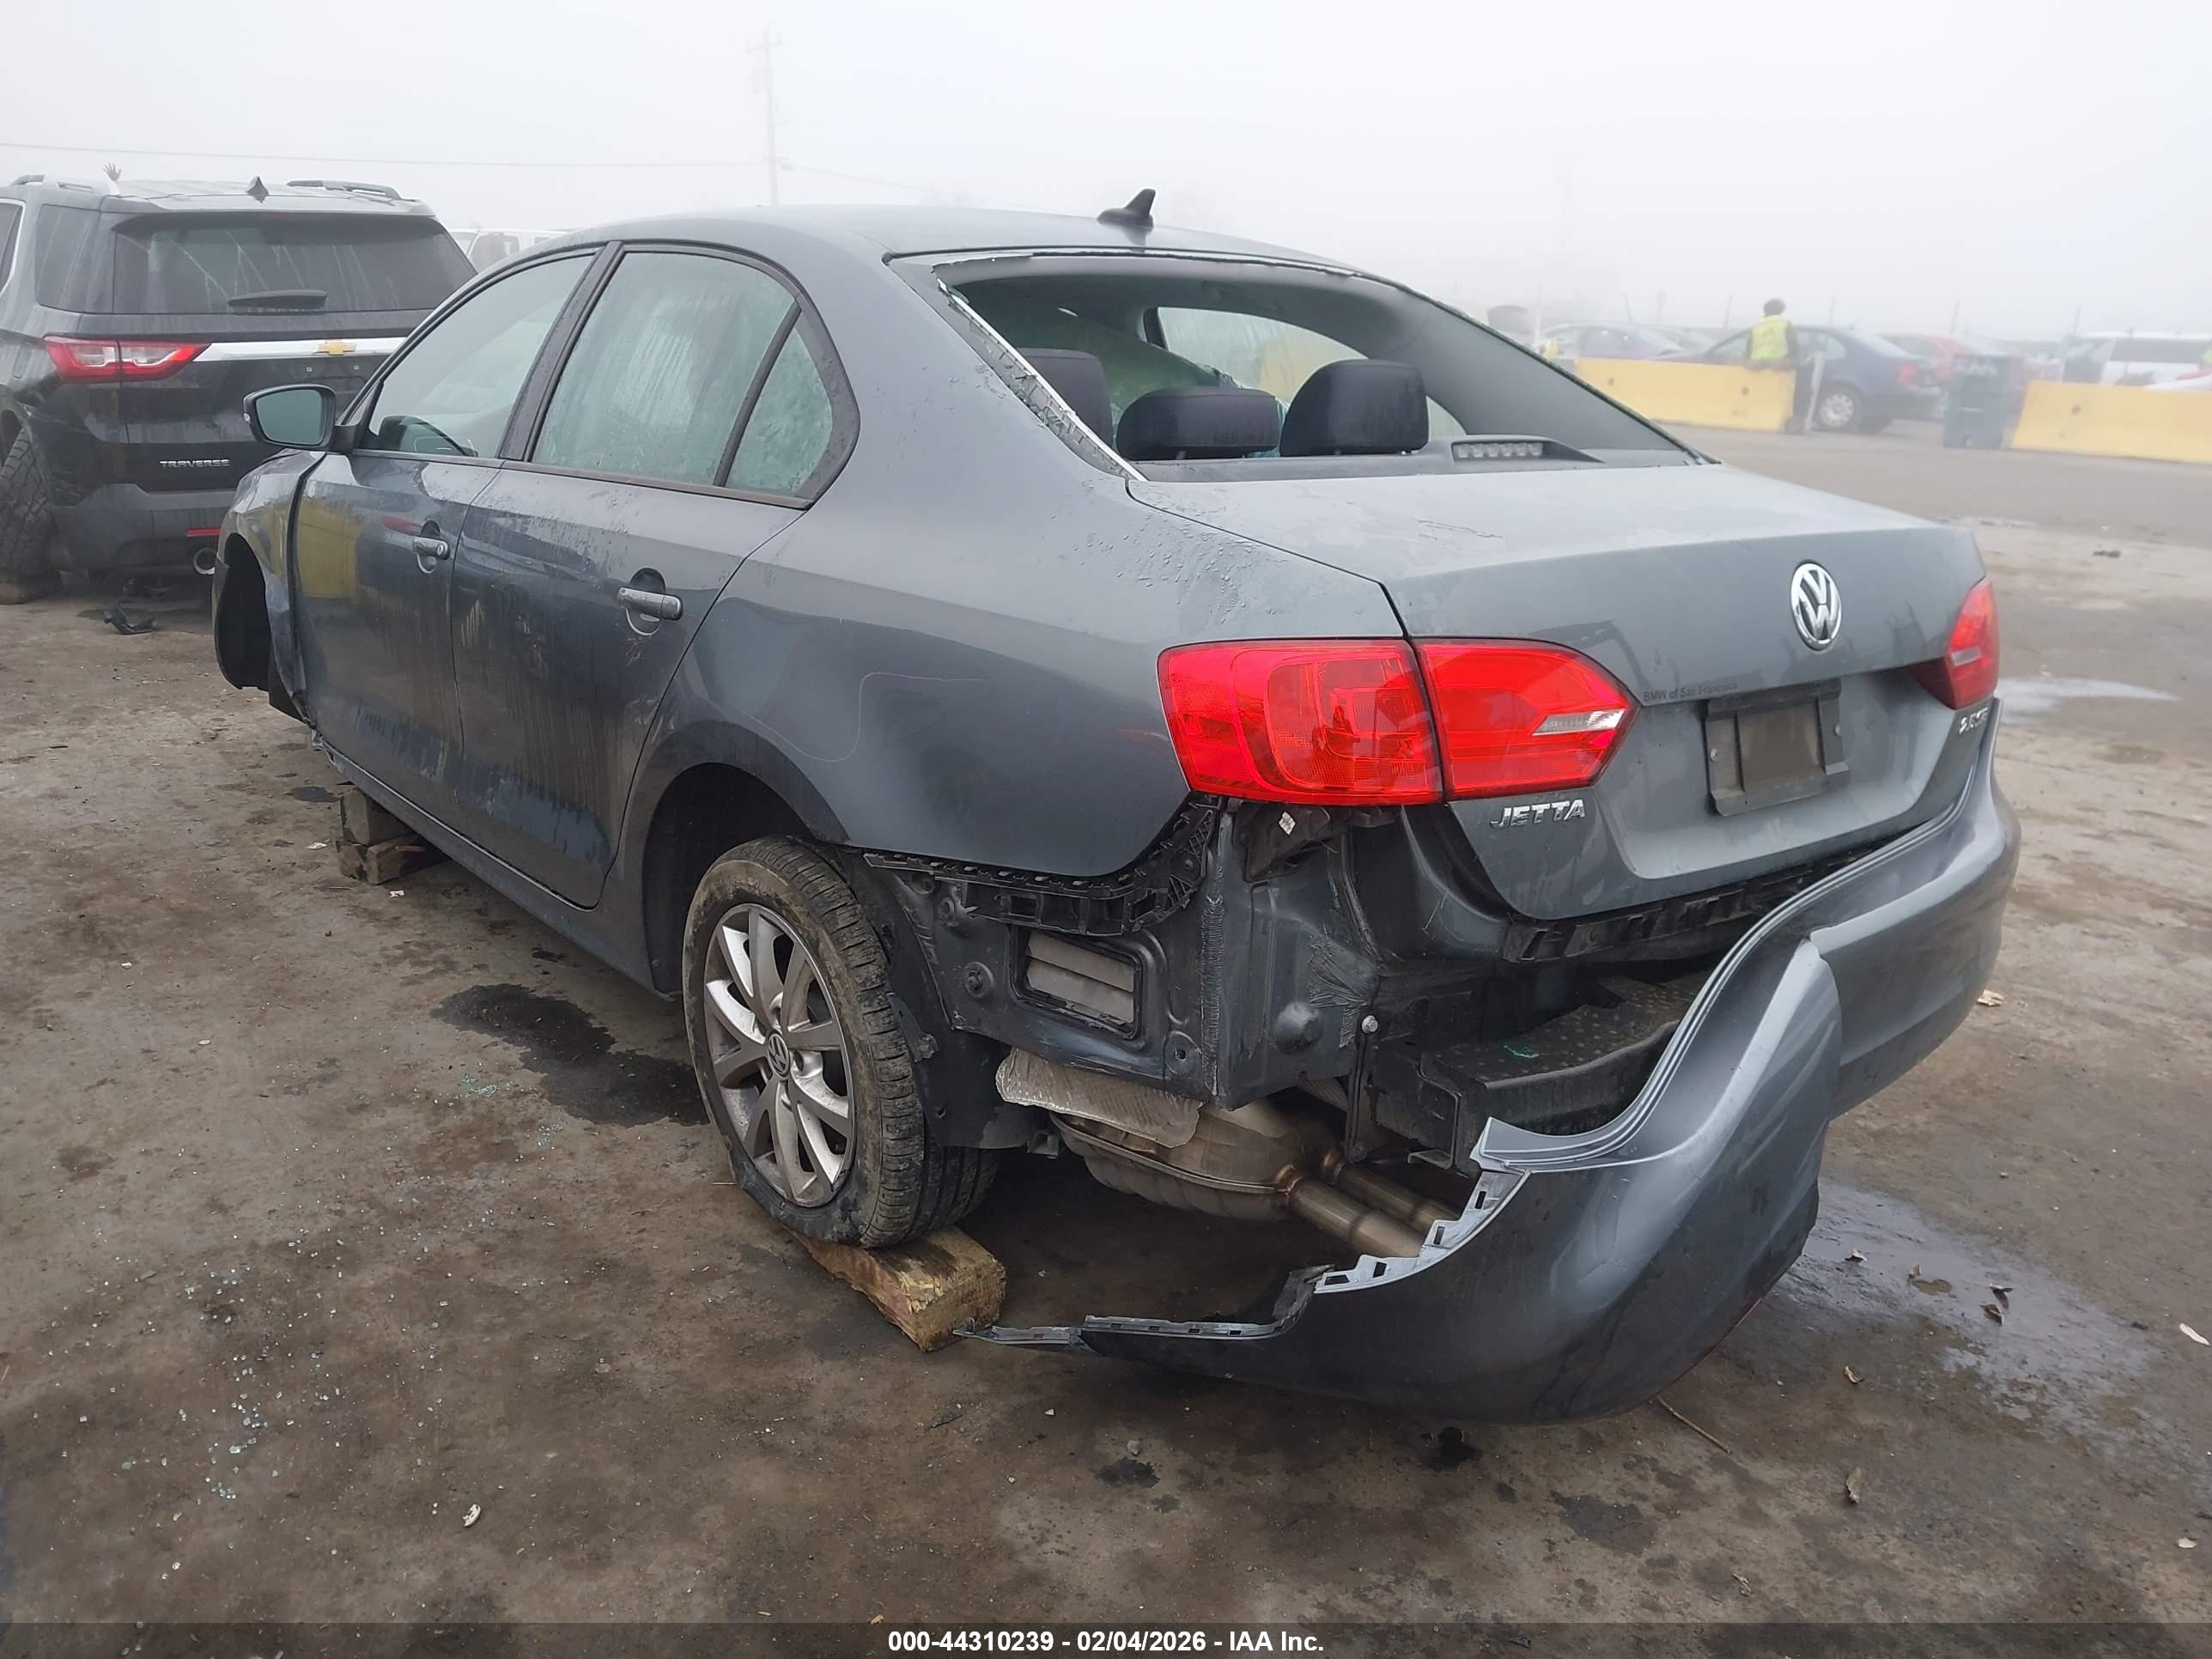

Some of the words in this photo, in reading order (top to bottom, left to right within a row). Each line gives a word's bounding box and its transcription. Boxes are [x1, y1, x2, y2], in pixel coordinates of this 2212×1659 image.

[158, 459, 230, 467] TRAVERSE
[1792, 563, 1840, 643] VW
[1644, 688, 1667, 702] BMW
[1668, 689, 1679, 699] of
[1680, 687, 1697, 697] San
[1490, 799, 1585, 828] JETTA
